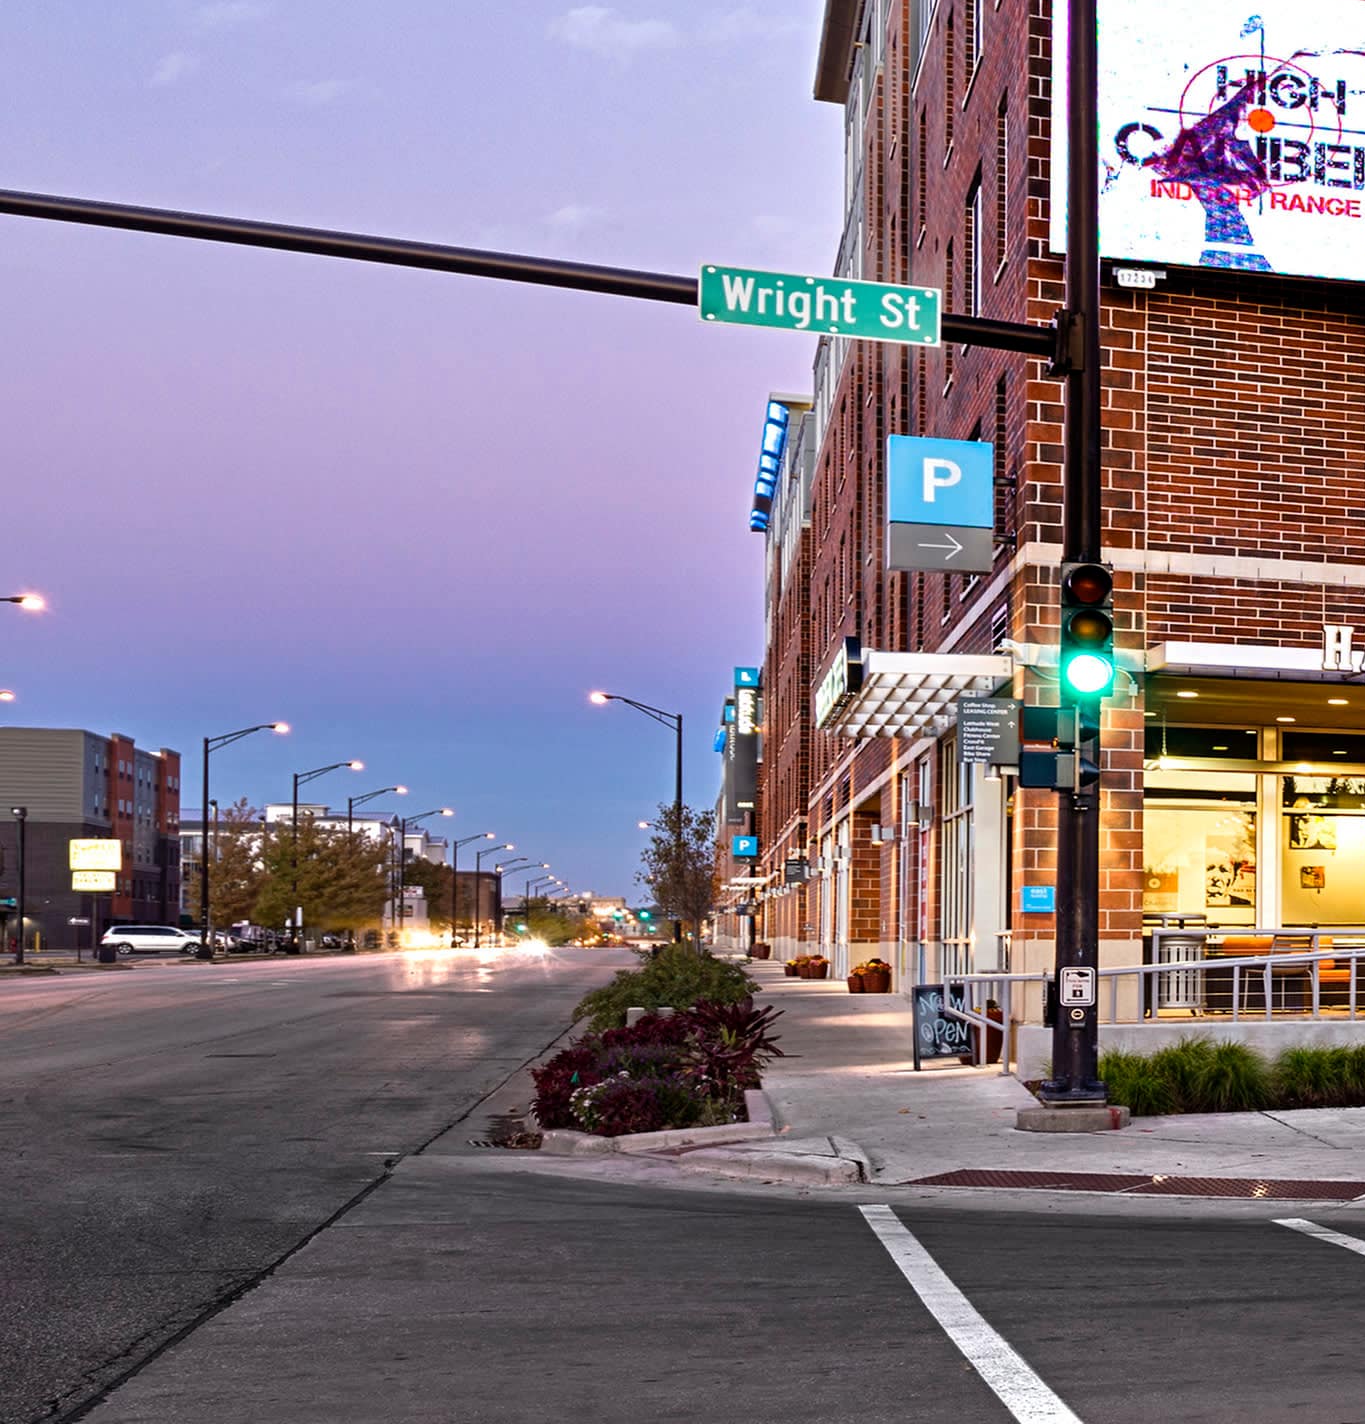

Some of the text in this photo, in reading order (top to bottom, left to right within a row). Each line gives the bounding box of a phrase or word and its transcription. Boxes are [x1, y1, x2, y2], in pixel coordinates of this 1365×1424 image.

[1216, 65, 1347, 115] HIGH
[1270, 190, 1362, 218] RANGE
[721, 274, 921, 331] Wright St
[922, 457, 962, 503] P
[739, 840, 751, 852] P
